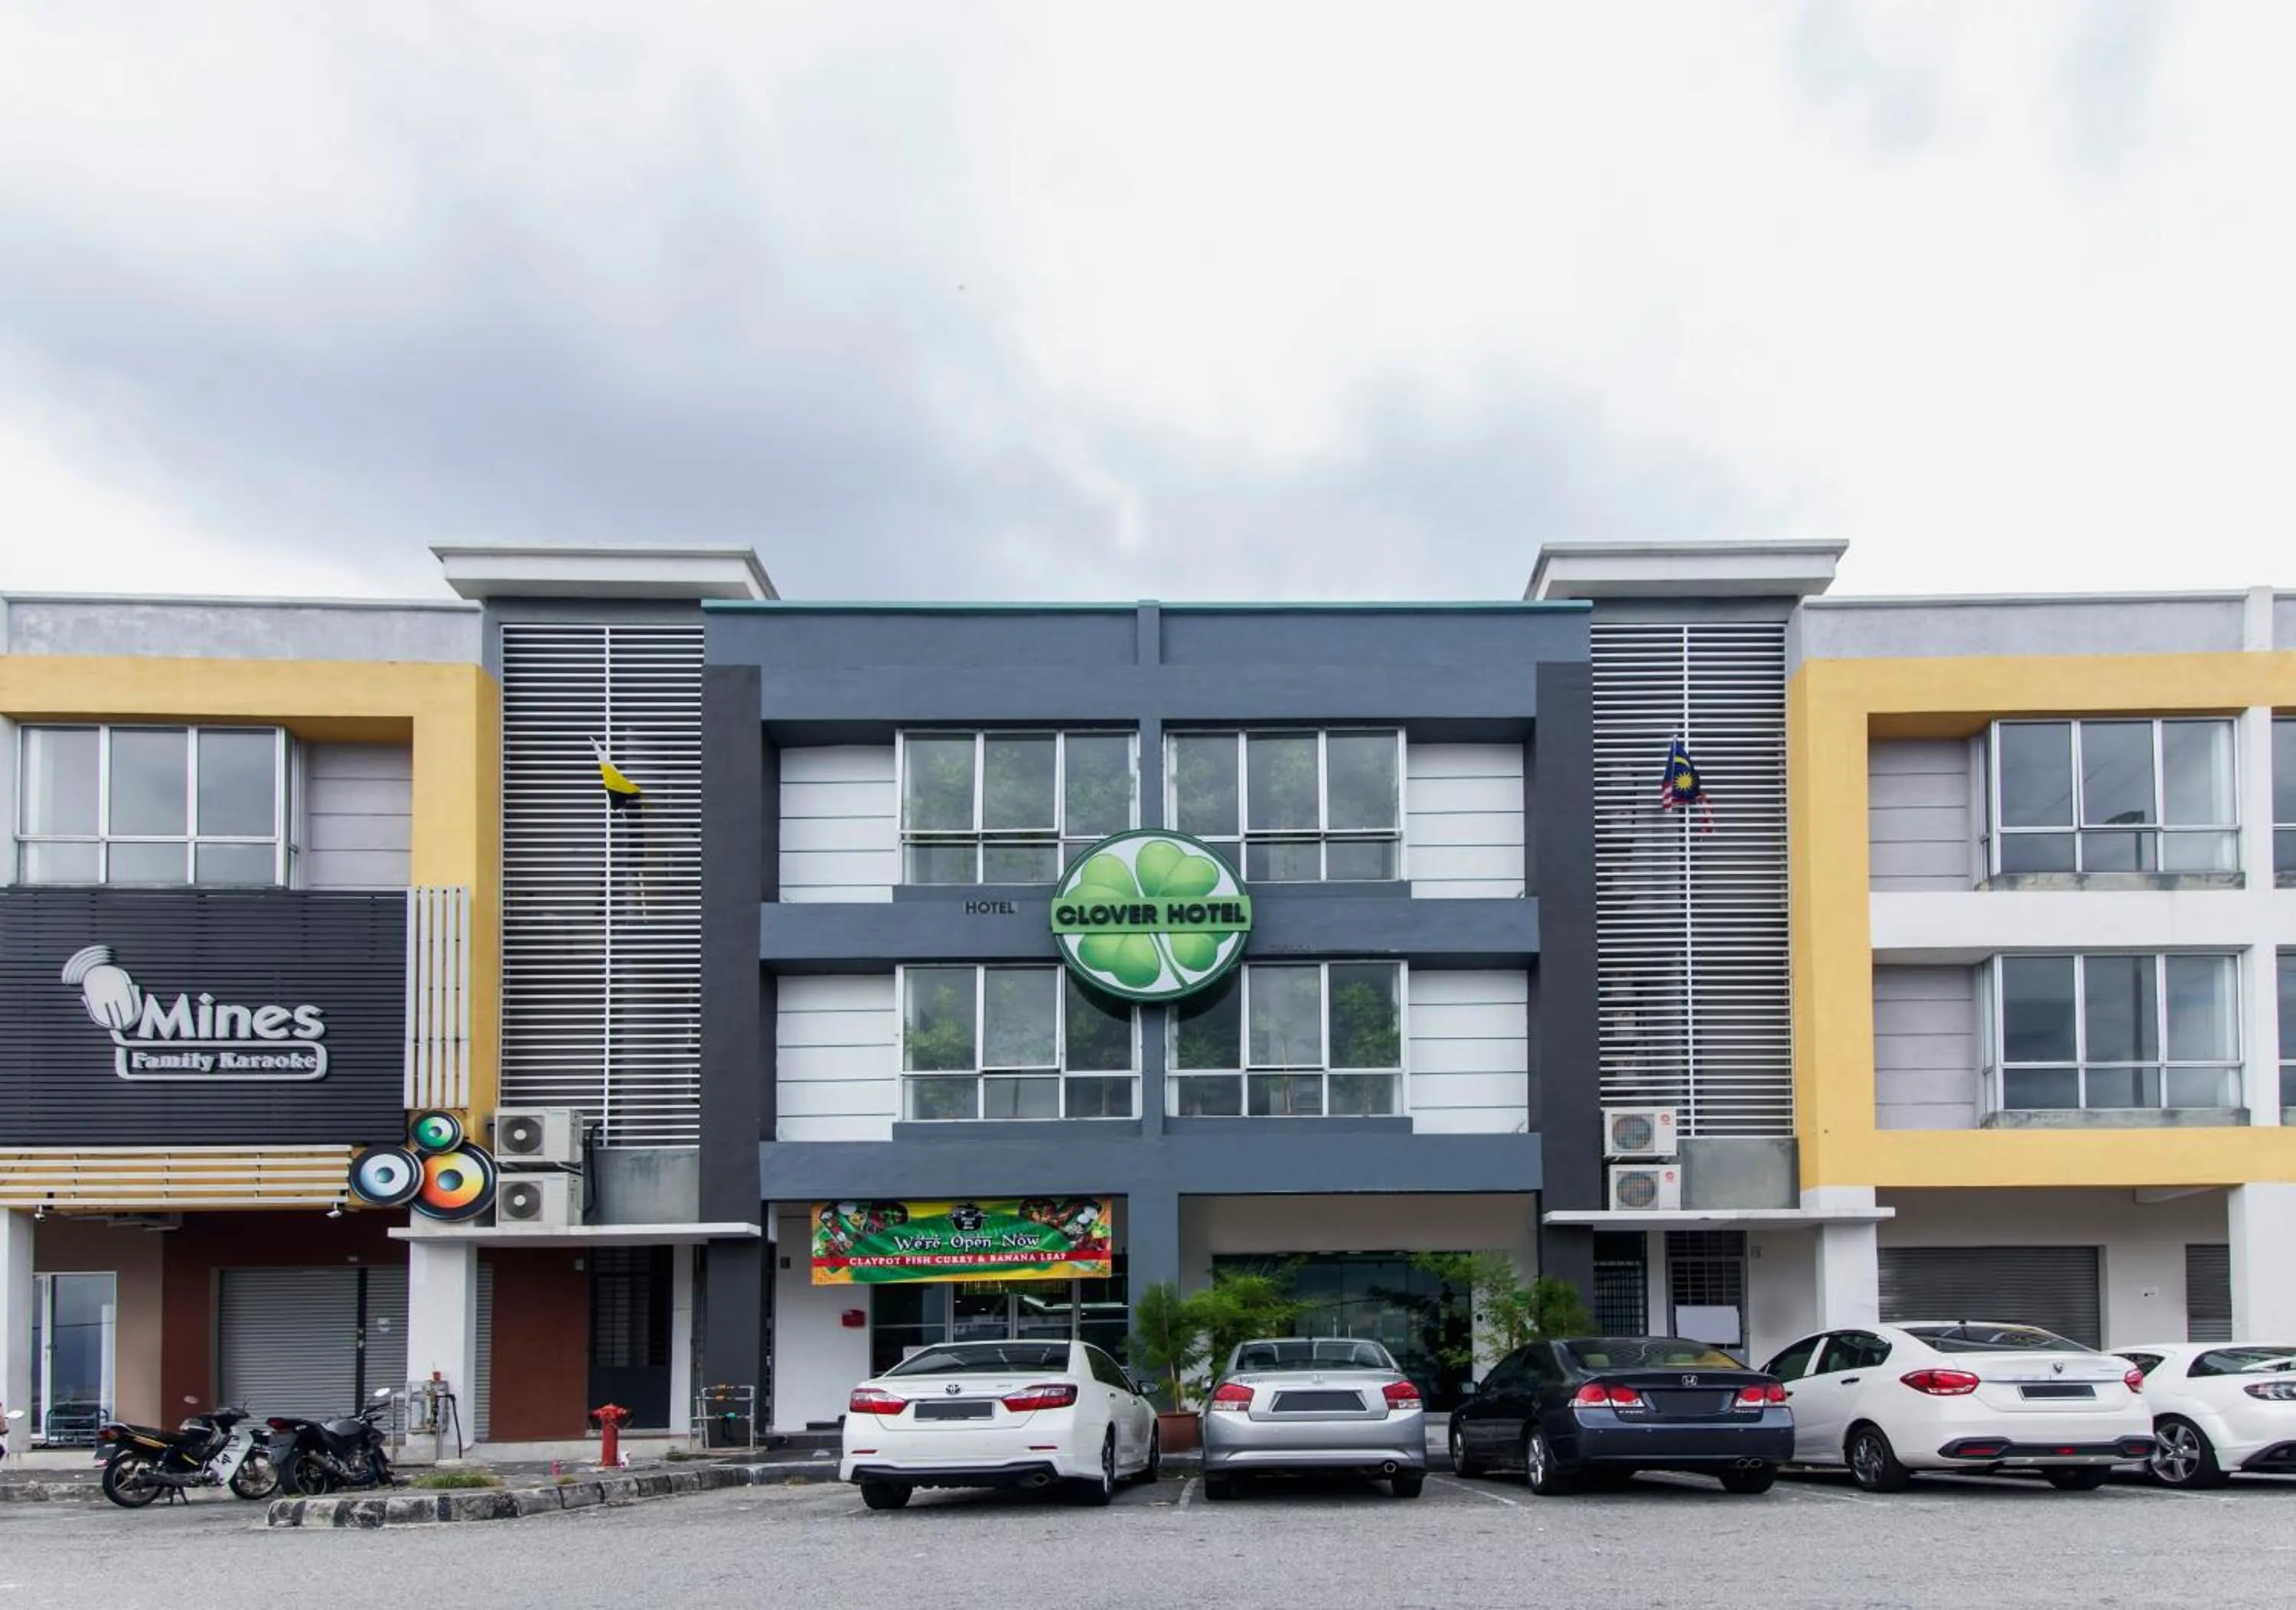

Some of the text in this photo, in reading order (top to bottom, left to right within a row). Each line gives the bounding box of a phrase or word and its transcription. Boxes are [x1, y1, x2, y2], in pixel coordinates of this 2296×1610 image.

[965, 901, 1016, 915] HOTEL
[1055, 902, 1247, 926] CLOVER HOTEL
[137, 992, 326, 1041] Mines
[131, 1051, 318, 1072] Family Karaoke
[951, 1234, 992, 1252] Open
[1001, 1234, 1039, 1247] Now
[849, 1252, 1066, 1266] CLAYPOT FISH CURRY & BANANA LEAF
